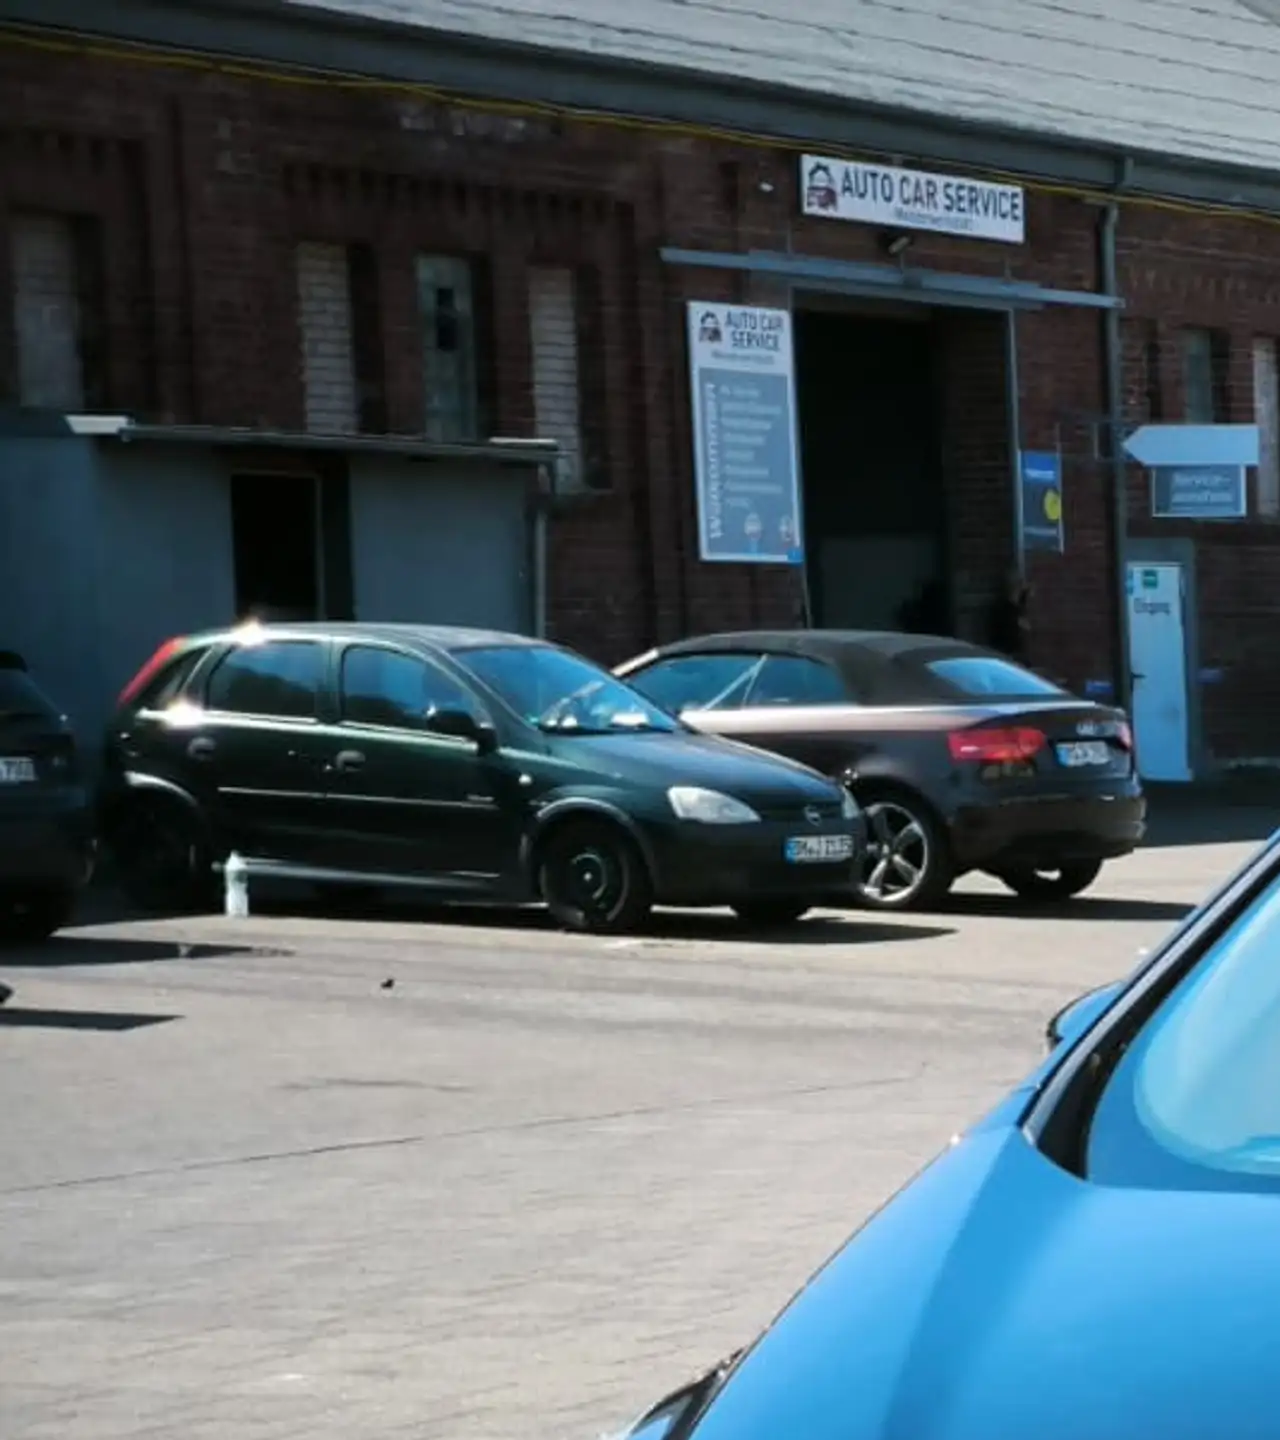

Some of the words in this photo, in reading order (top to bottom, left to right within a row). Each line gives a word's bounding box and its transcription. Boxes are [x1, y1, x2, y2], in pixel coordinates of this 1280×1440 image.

[841, 167, 894, 204] AUTO
[900, 176, 939, 210] CAR
[943, 183, 1021, 222] SERVICE
[725, 310, 758, 331] AUTO
[760, 315, 784, 334] CAR
[731, 330, 781, 351] SERVICE
